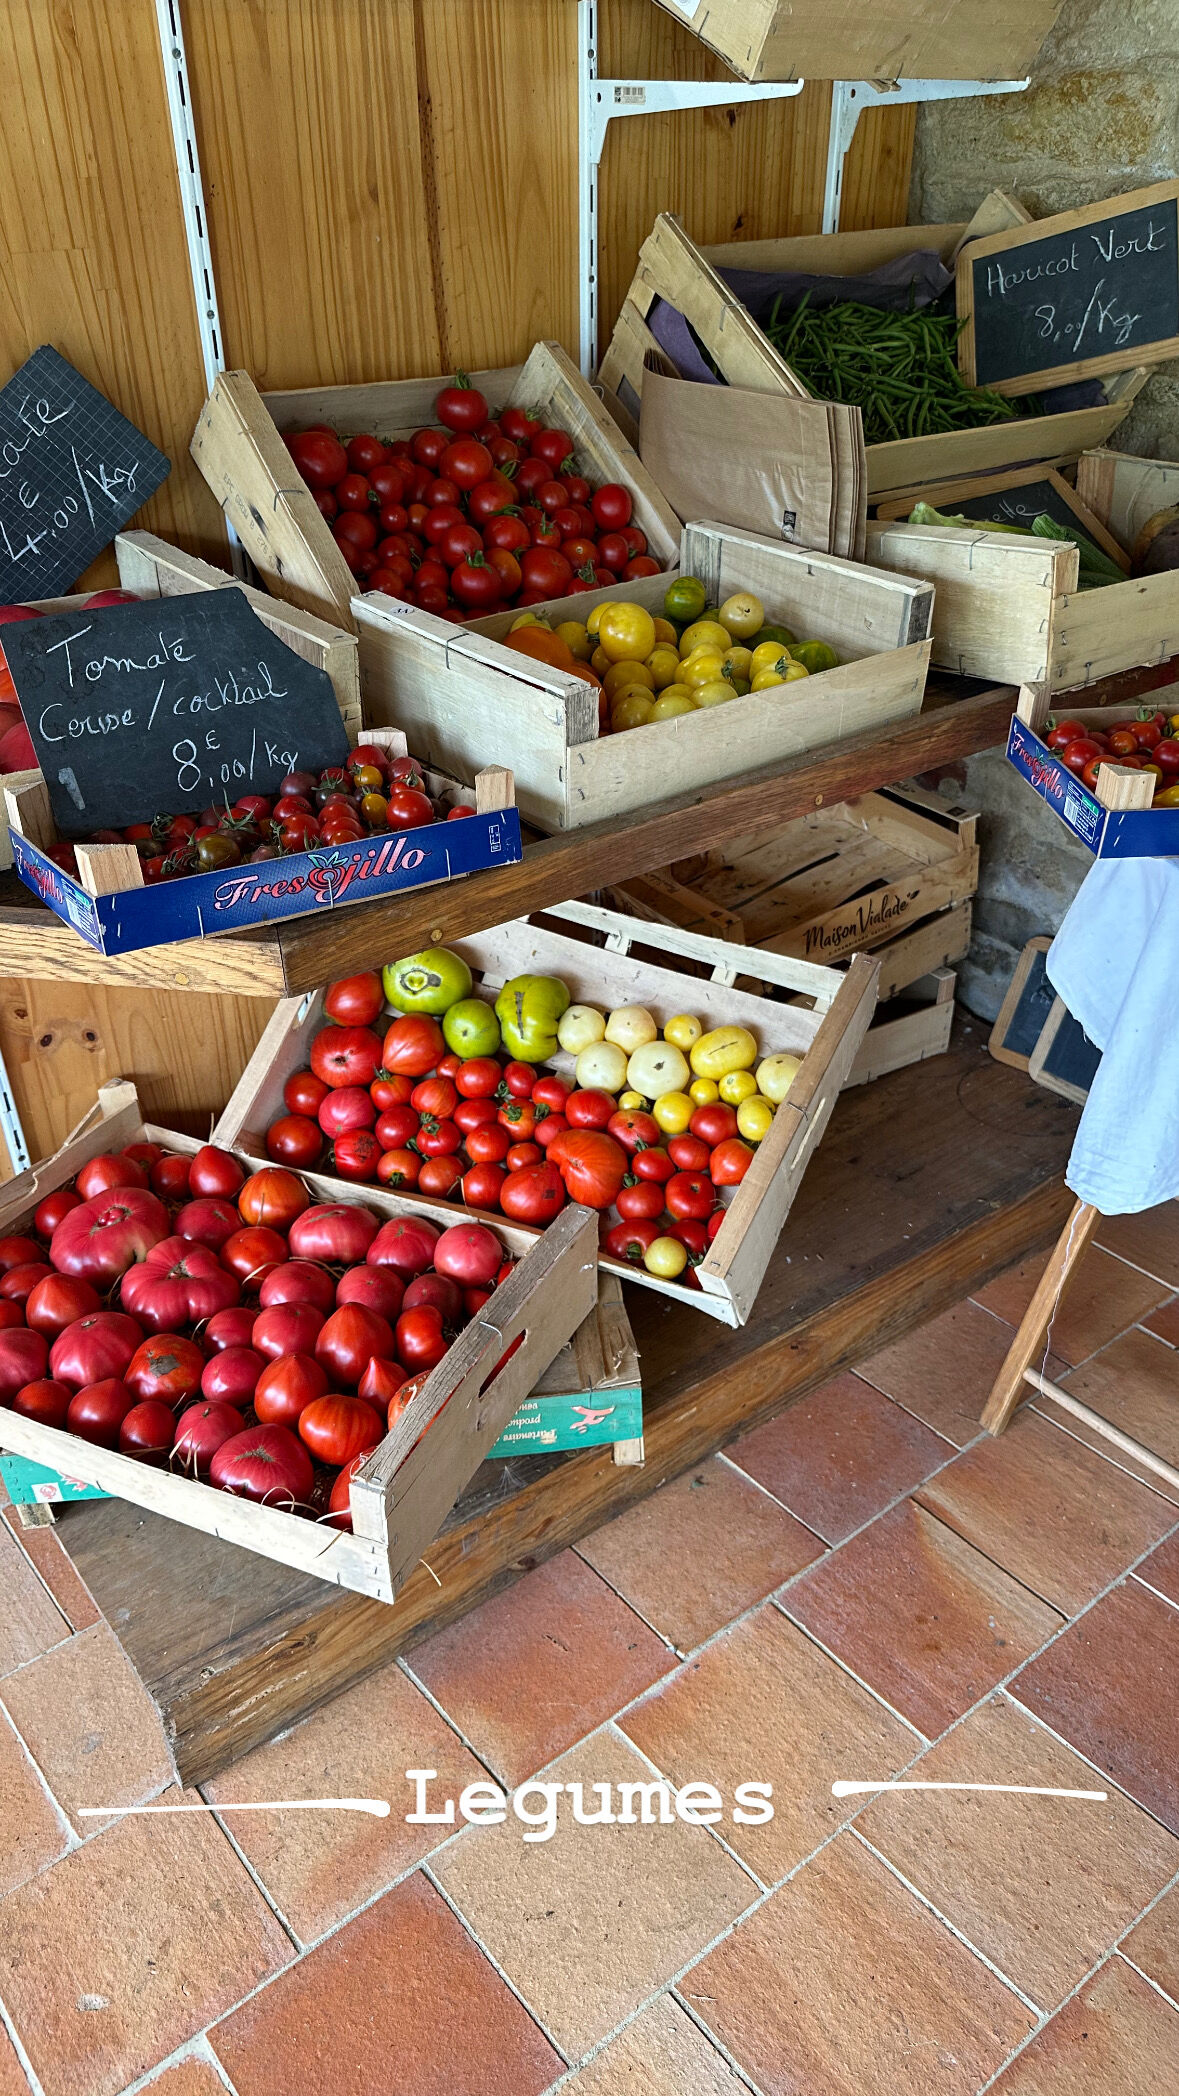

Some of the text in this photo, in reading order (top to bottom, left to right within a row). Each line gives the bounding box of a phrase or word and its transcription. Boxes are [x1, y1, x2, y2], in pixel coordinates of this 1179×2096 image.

[987, 220, 1166, 298] Haricot Vert
[802, 924, 857, 956] Maison
[855, 894, 909, 934] Vialade
